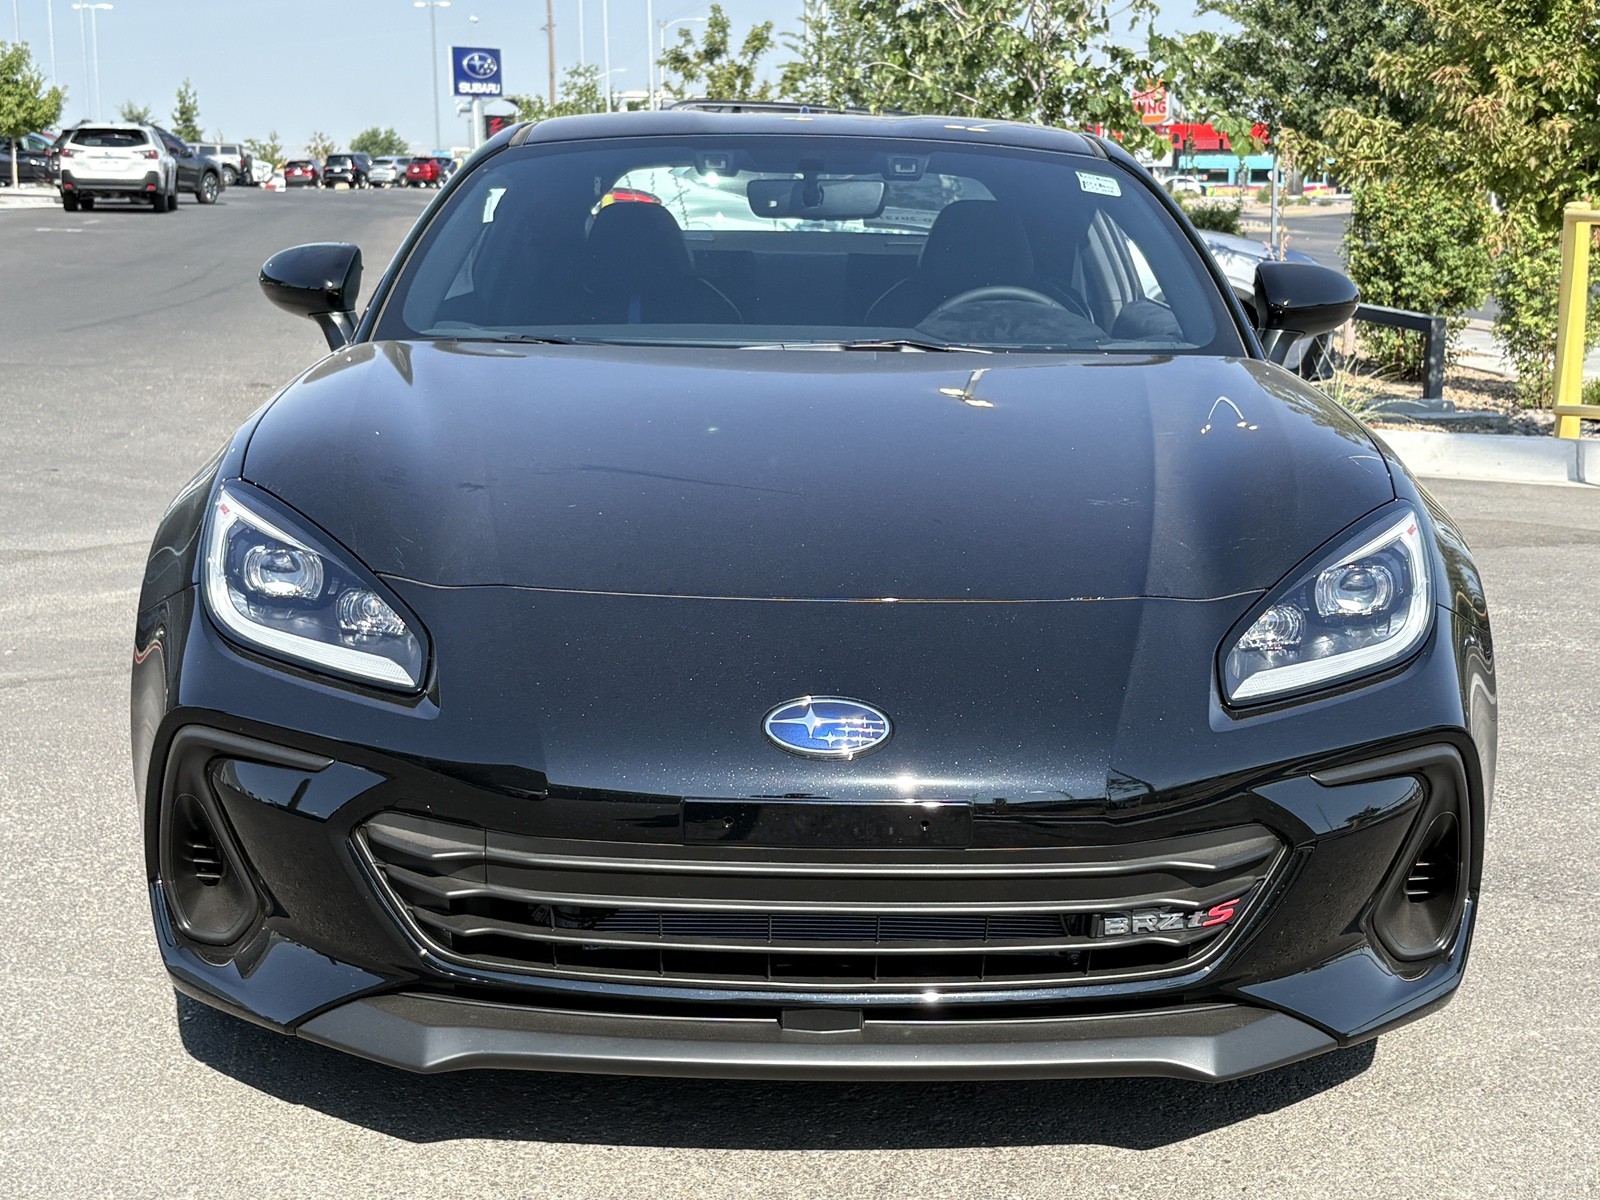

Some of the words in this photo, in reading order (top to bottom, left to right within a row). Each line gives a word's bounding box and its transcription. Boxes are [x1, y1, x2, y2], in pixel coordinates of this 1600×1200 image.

[458, 81, 501, 95] SUBARU
[1103, 911, 1185, 936] BRZ
[1187, 898, 1240, 930] tS
